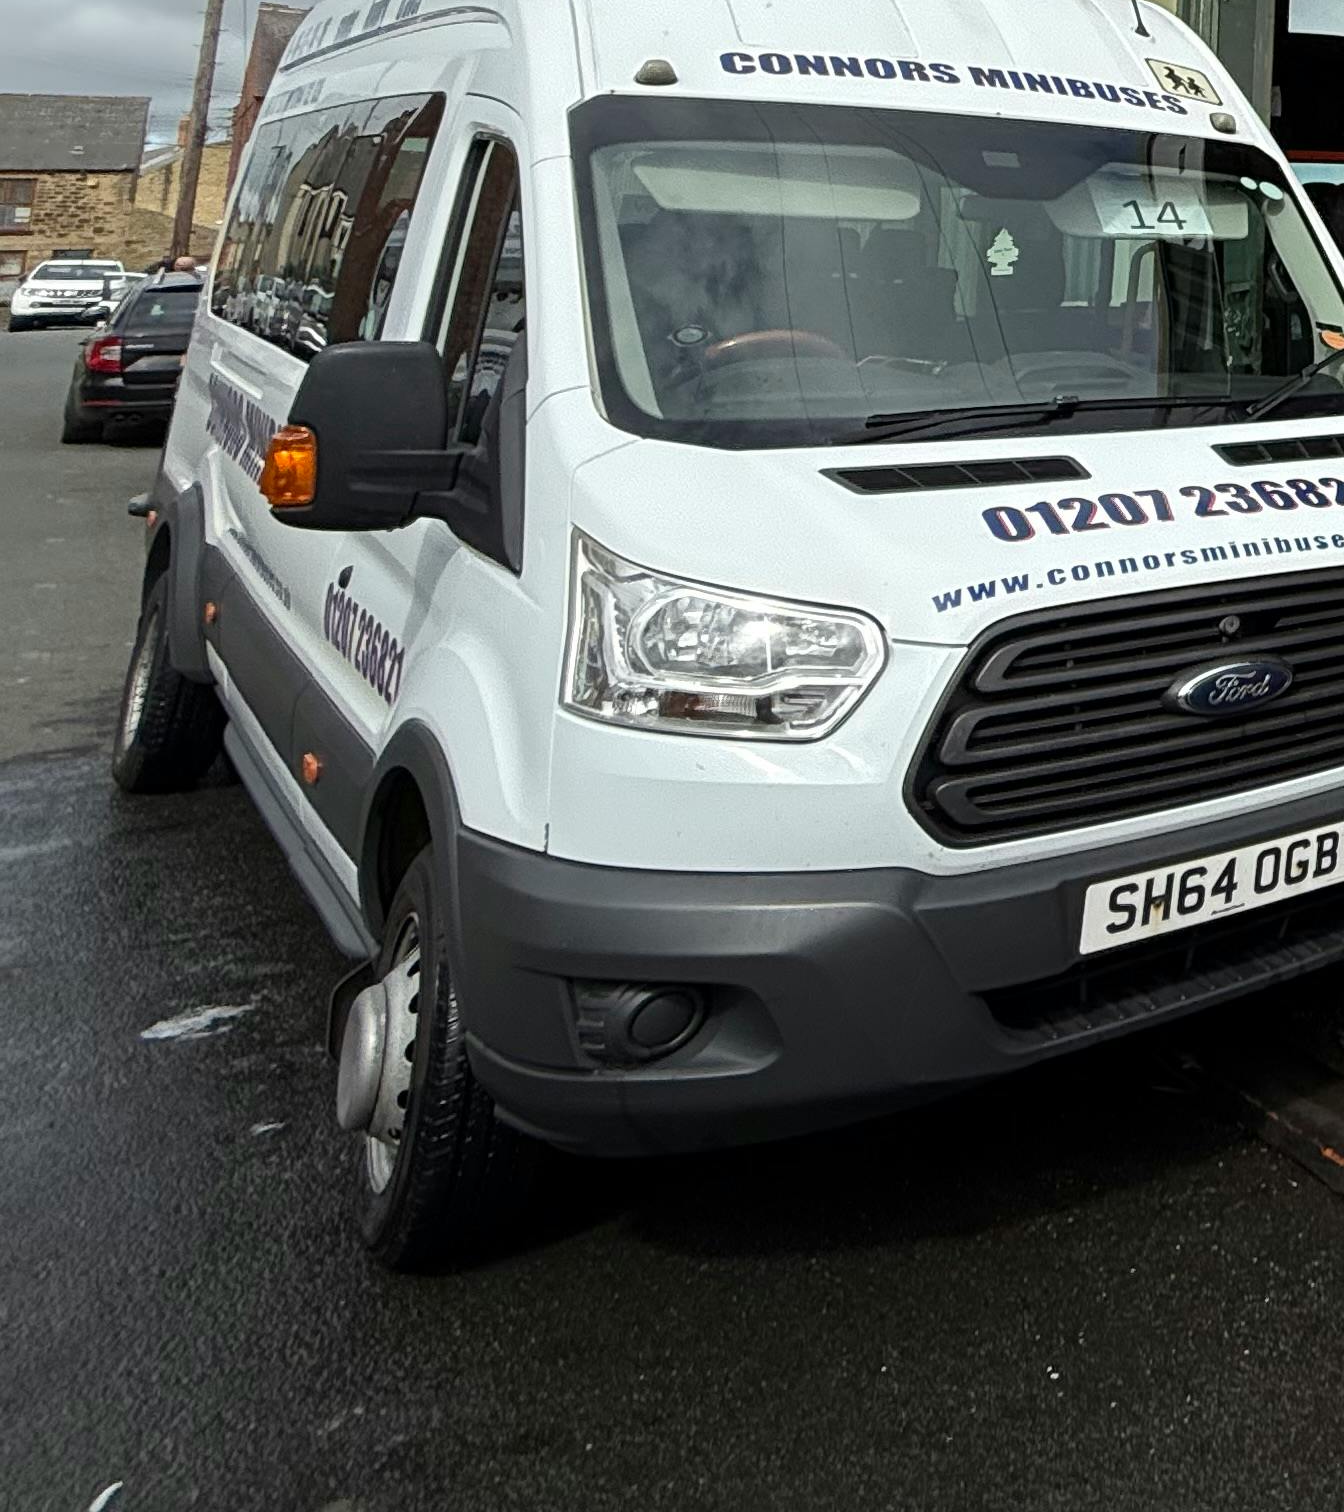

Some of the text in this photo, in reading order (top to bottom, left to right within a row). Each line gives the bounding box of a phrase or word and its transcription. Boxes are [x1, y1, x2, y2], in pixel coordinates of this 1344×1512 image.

[719, 52, 1188, 115] CONNORS MINIBUSES
[1122, 199, 1187, 231] 14
[982, 488, 1175, 543] 01207
[354, 608, 405, 707] 236821
[1208, 670, 1272, 706] Ford
[1105, 831, 1339, 934] SH64 OGB
